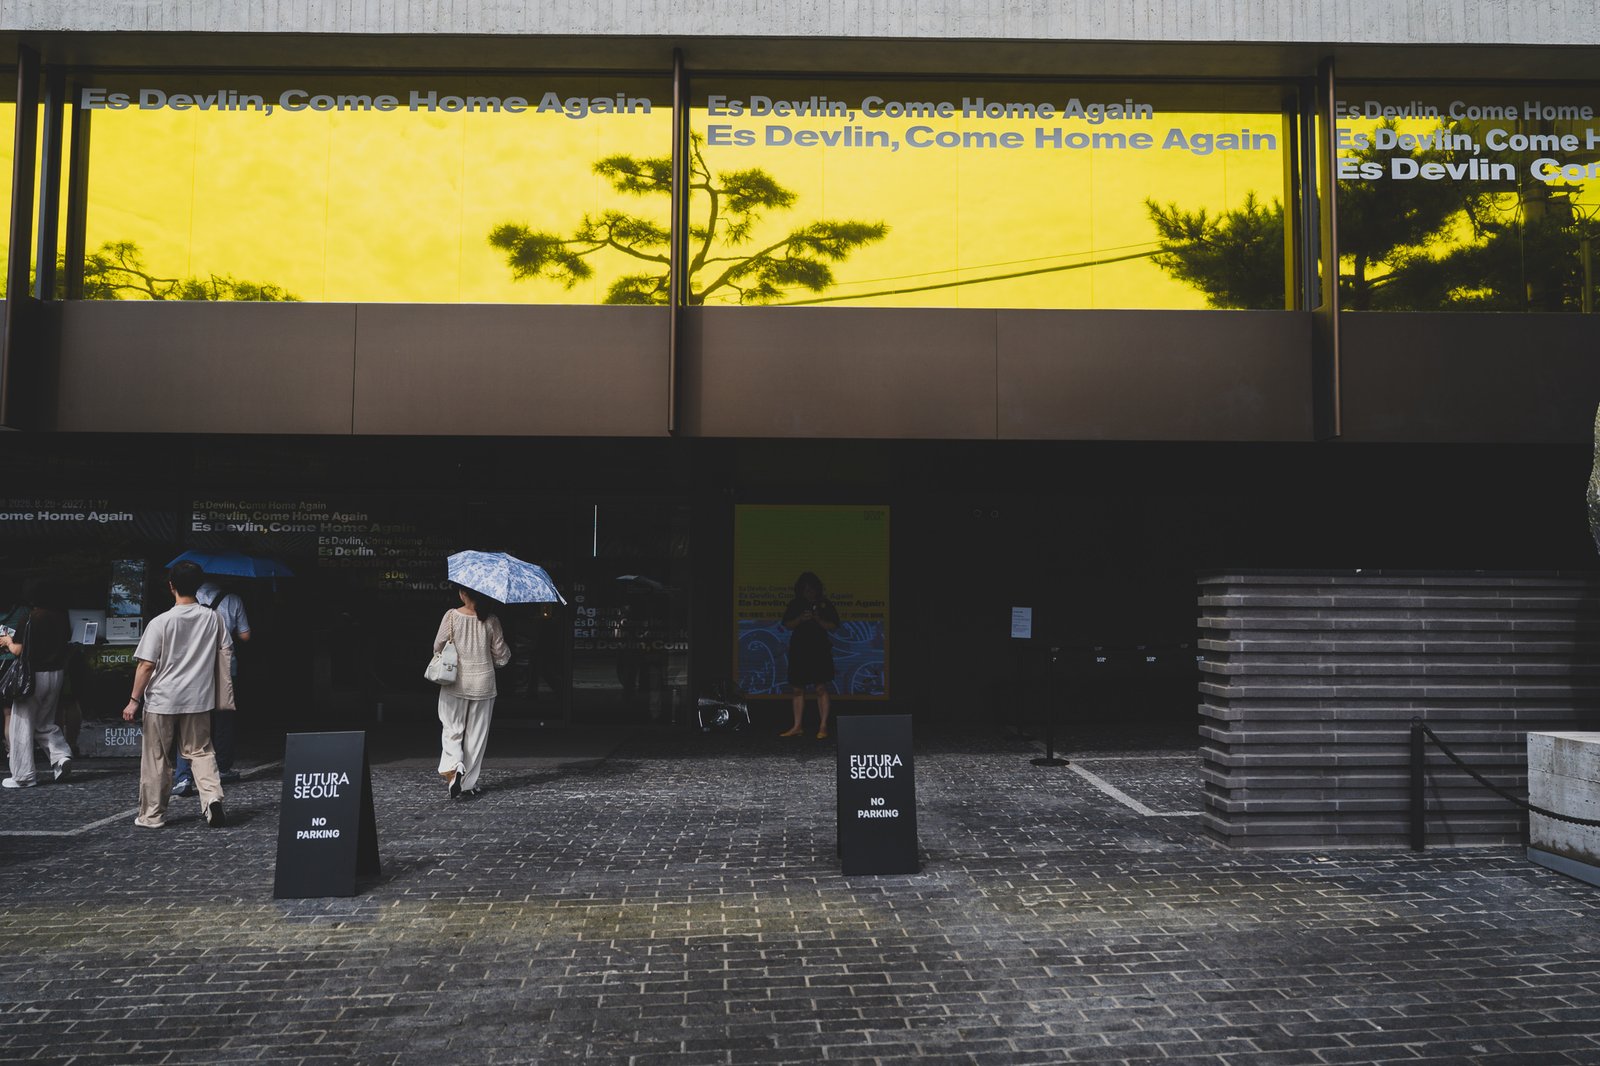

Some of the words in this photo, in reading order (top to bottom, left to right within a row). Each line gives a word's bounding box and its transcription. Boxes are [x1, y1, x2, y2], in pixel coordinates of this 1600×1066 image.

[81, 88, 129, 109] Es
[139, 88, 273, 116] Devlin,
[280, 89, 398, 112] Come
[410, 90, 528, 114] Home
[537, 92, 652, 119] Again
[708, 95, 743, 117] Es
[750, 95, 855, 121] Devlin,
[861, 96, 955, 119] Come
[962, 97, 1057, 120] Home
[1063, 98, 1153, 124] Again
[1336, 101, 1360, 120] Es
[1365, 101, 1444, 122] Devlin,
[1450, 101, 1518, 120] Come
[1524, 101, 1593, 120] Home
[708, 125, 756, 146] Es
[765, 125, 900, 152] Devlin,
[905, 126, 1024, 149] Come
[1036, 127, 1154, 150] Home
[1162, 128, 1277, 155] Again
[1336, 128, 1370, 150] Es
[1375, 128, 1480, 155] Devlin,
[1485, 128, 1579, 151] Come
[1337, 158, 1383, 180] Es
[1391, 157, 1516, 180] Devlin
[192, 500, 205, 509] Es
[269, 501, 296, 510] Home
[299, 501, 327, 512] Again
[38, 511, 84, 521] Home
[87, 511, 134, 523] Again
[192, 511, 207, 520] Es
[209, 511, 251, 522] Devlin,
[253, 511, 289, 521] Come
[292, 512, 329, 521] Home
[331, 512, 368, 522] Again
[192, 522, 211, 532] Es
[214, 522, 268, 534] Devlin,
[269, 522, 317, 532] Come
[320, 523, 367, 533] Home
[318, 536, 330, 545] Es
[318, 547, 333, 556] Es
[102, 655, 129, 663] TICKET
[105, 728, 143, 738] FUTURA
[104, 737, 137, 746] SEOUL
[850, 754, 903, 767] FUTURA
[850, 766, 895, 779] SEOUL
[295, 772, 350, 787] FUTURA
[293, 785, 340, 799] SEOUL
[870, 797, 885, 806] NO
[857, 809, 899, 819] PARKING
[311, 817, 327, 827] NO
[296, 829, 340, 840] PARKING
